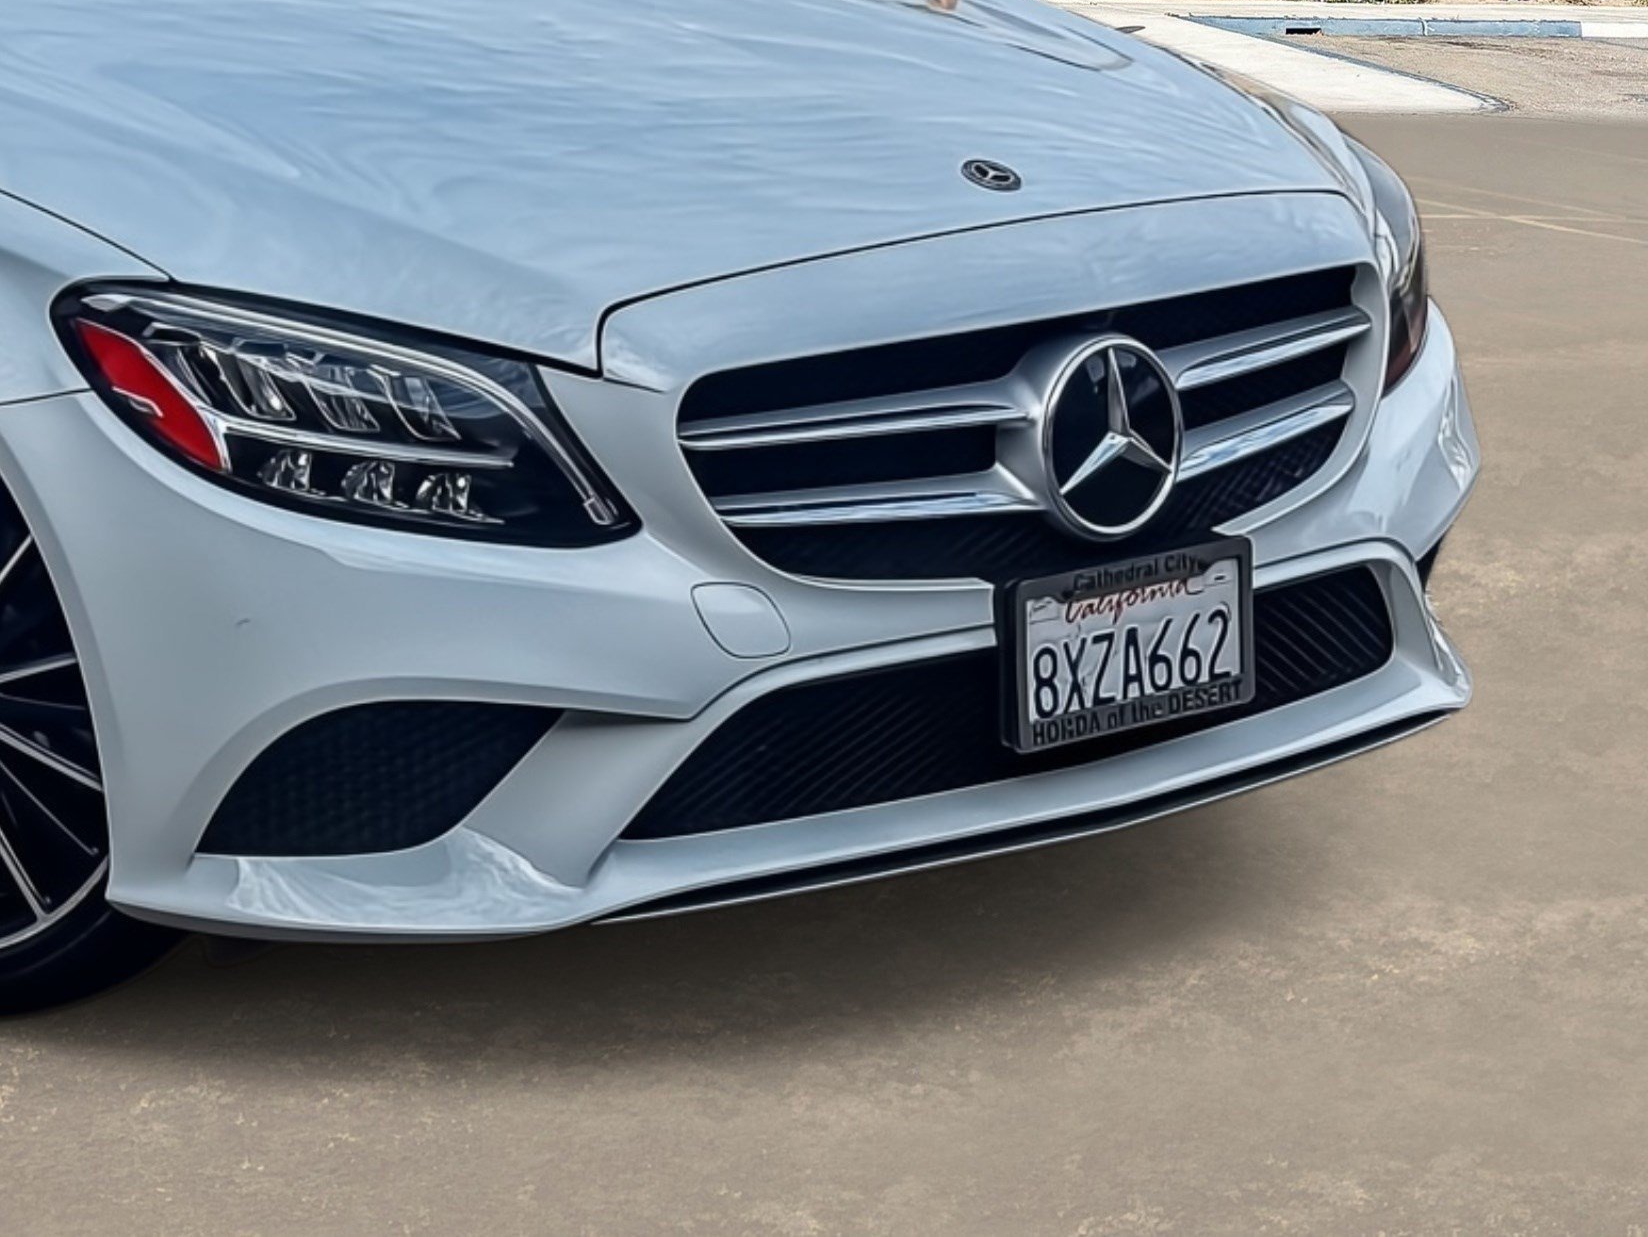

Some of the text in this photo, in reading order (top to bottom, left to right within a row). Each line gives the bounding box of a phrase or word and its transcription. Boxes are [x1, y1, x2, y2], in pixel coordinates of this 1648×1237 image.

[1071, 553, 1199, 592] Cathedral City
[1064, 578, 1204, 625] California
[1032, 608, 1232, 719] 8XZA662
[1033, 679, 1243, 746] HONDA of the DESERT
